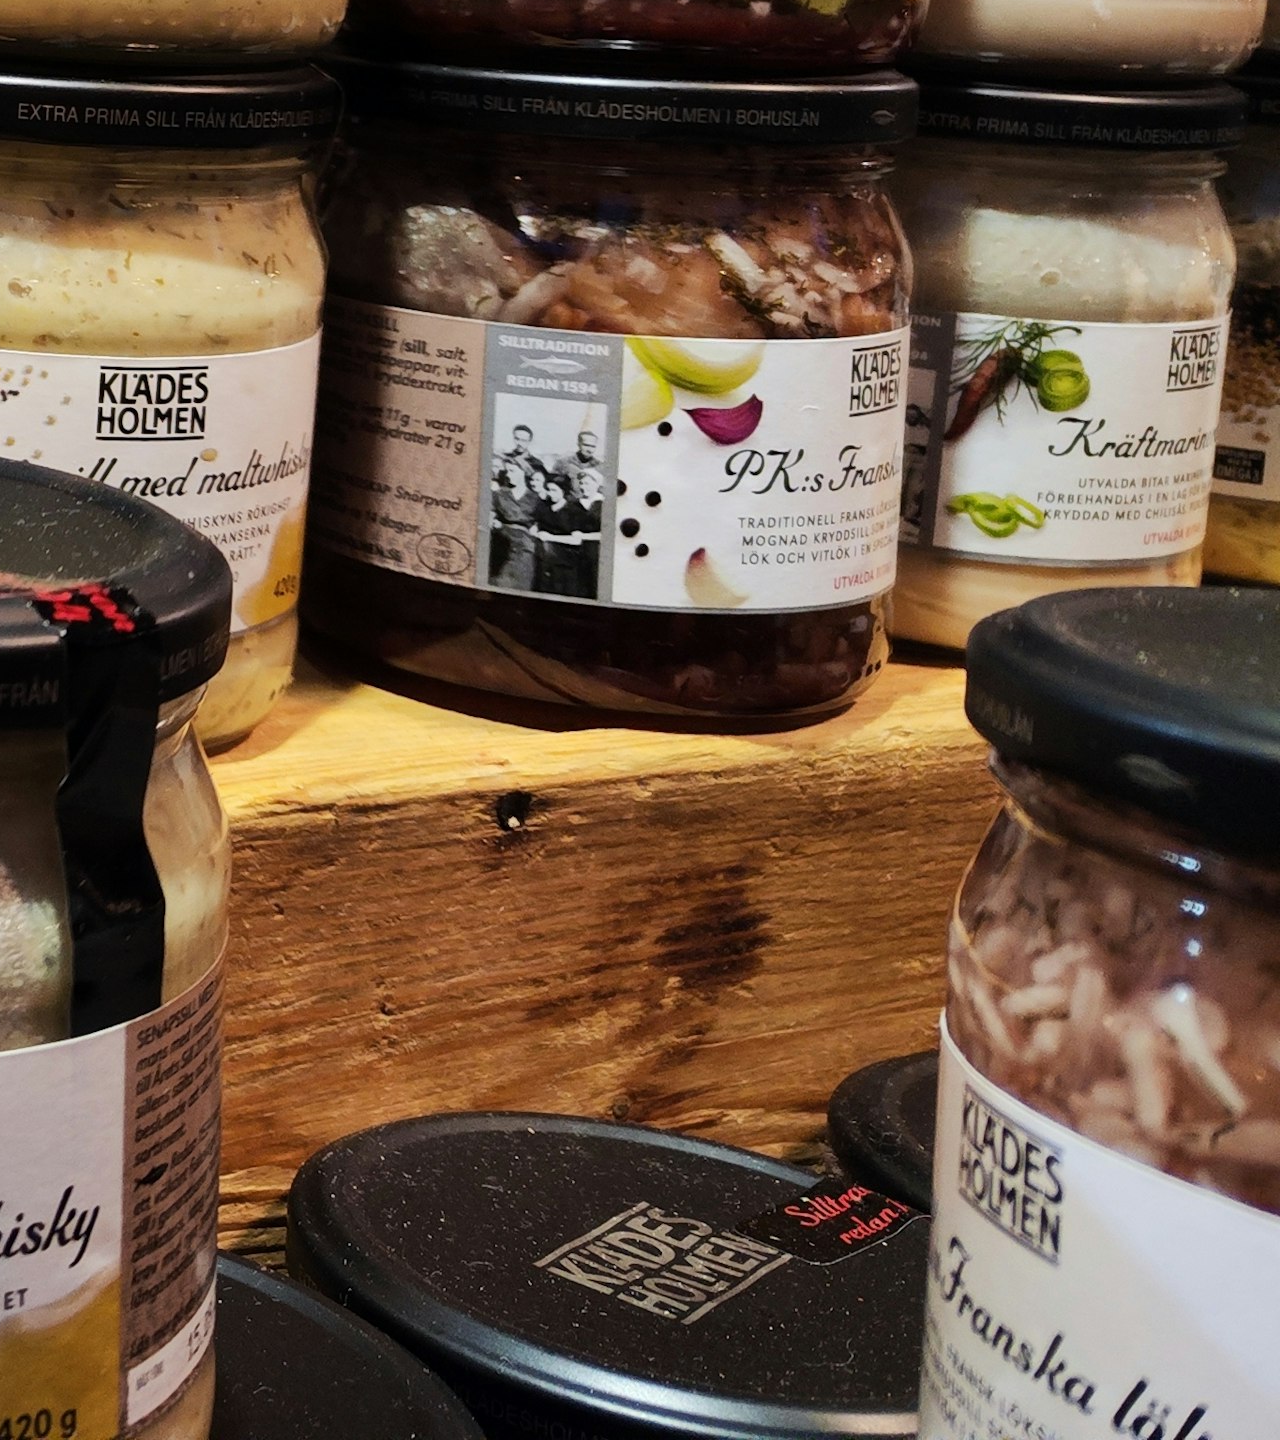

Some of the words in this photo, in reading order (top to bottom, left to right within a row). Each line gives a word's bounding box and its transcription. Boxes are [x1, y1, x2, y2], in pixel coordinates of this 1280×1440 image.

[17, 103, 78, 123] EXTRA
[84, 106, 140, 125] PRIMA
[146, 109, 180, 128] SILL
[499, 335, 609, 356] SILLTRADITION
[1171, 333, 1220, 360] KLÄDES
[851, 346, 901, 382] KLÄDES
[1168, 363, 1214, 387] HOLMEN
[98, 372, 209, 404] KLÄDES
[506, 374, 558, 390] REDAN
[850, 378, 899, 411] HOLMEN
[97, 406, 205, 434] HOLMEN
[719, 449, 822, 494] PK:s
[1079, 477, 1136, 488] UTVALDA
[739, 515, 836, 528] TRADITIONELL
[1044, 509, 1109, 521] KRYDDAD
[742, 533, 807, 546] MOGNAD
[741, 551, 769, 565] LÖK
[777, 552, 805, 564] OCH
[811, 546, 850, 562] VITLÖK
[964, 1100, 1062, 1204] KLÄDES
[961, 1156, 1059, 1253] HOLMEN
[840, 1211, 896, 1245] redan
[548, 1208, 713, 1295] KLÄDES
[617, 1231, 779, 1318] HOLMEN
[943, 1236, 1095, 1415] Franska
